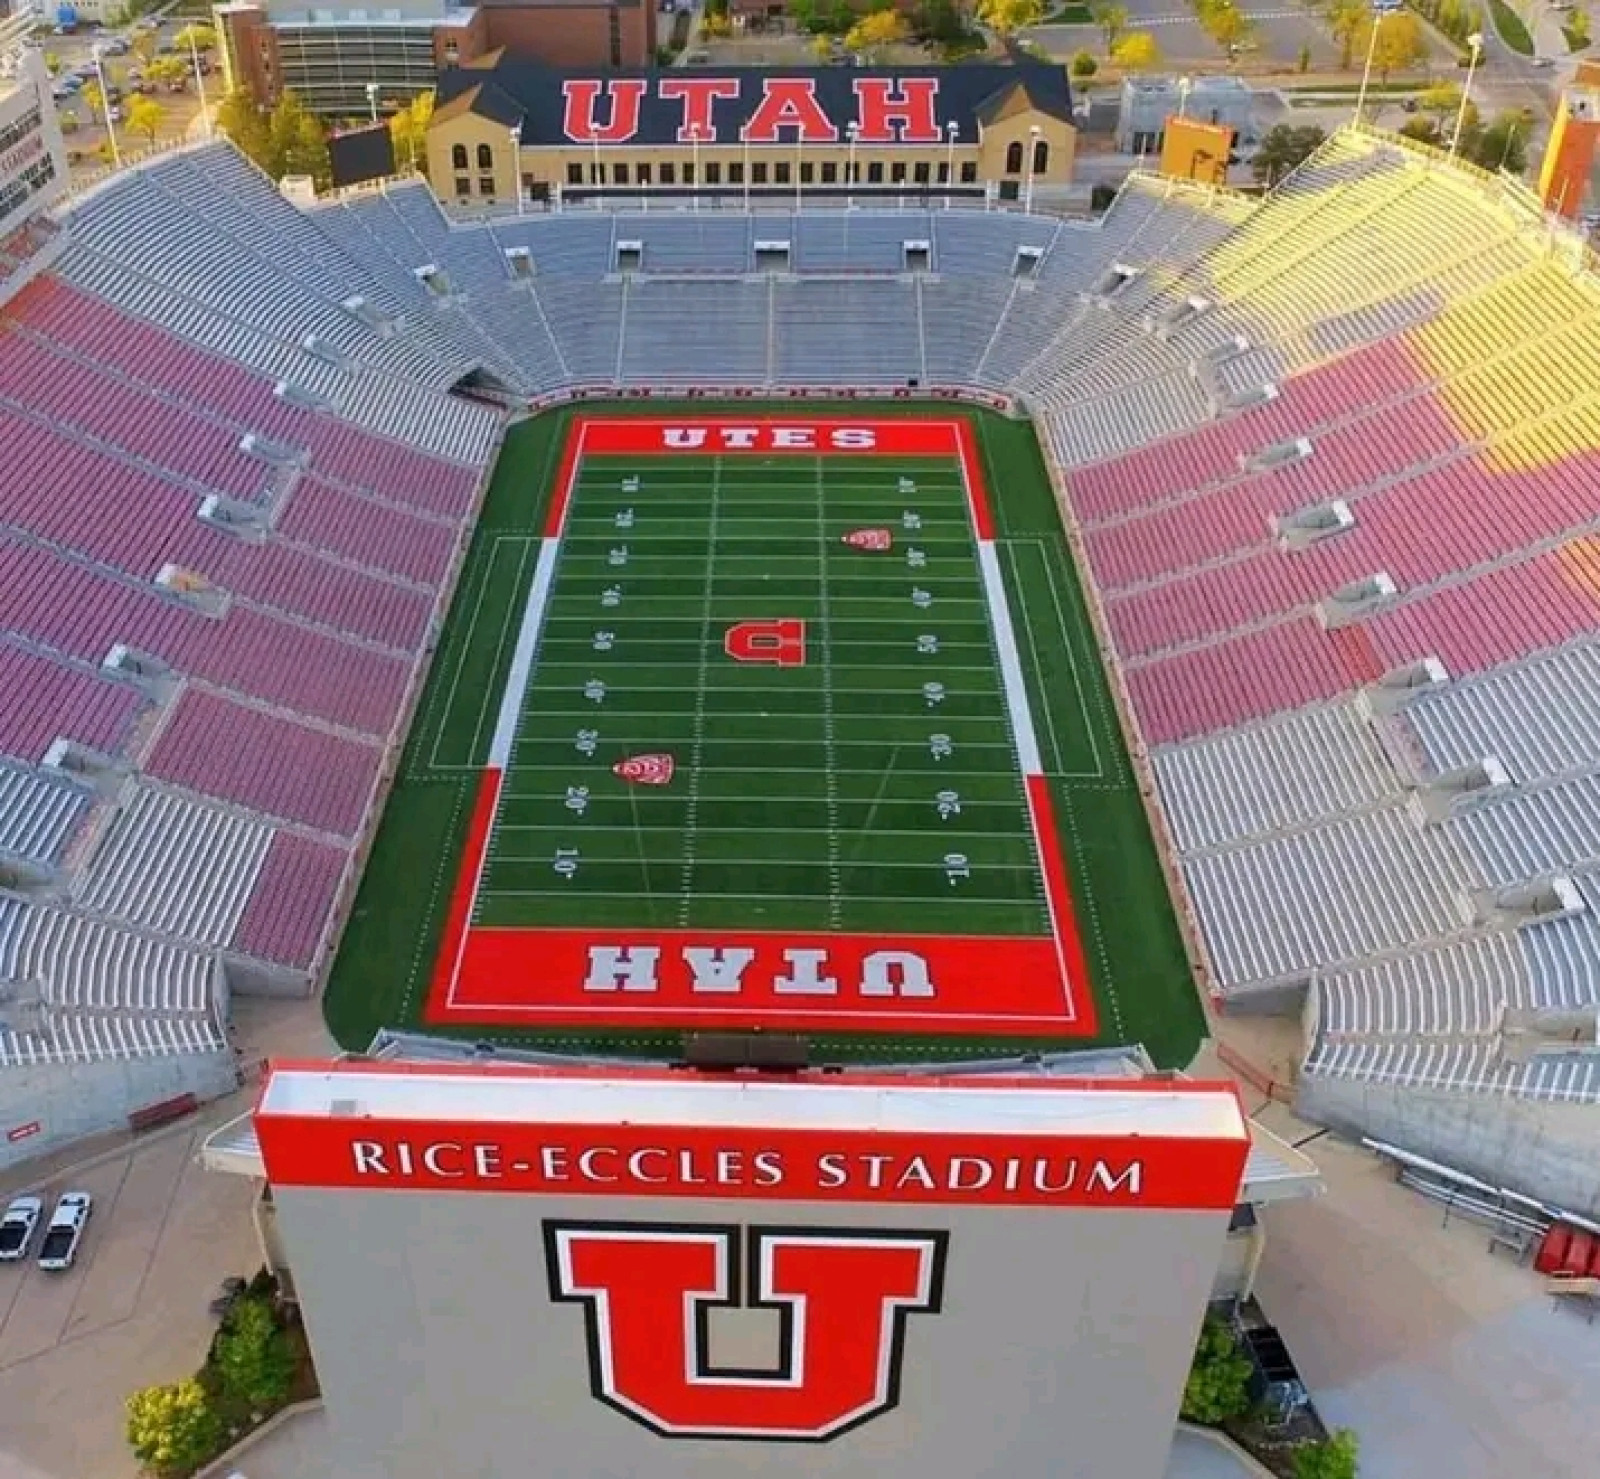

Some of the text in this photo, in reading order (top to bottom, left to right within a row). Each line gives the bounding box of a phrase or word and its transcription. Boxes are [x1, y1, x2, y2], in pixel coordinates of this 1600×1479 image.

[562, 78, 942, 142] UTAH
[661, 427, 878, 449] UTES
[592, 630, 615, 650] 50
[725, 619, 806, 667] U
[916, 634, 938, 654] 50
[583, 678, 606, 700] 40
[922, 681, 945, 702] 40
[575, 728, 599, 751] 30
[928, 733, 952, 756] 30
[565, 785, 590, 809] 20
[935, 790, 961, 814] 20
[552, 847, 580, 874] 10
[943, 852, 970, 878] 10
[583, 944, 935, 998] UTAH
[350, 1139, 1143, 1194] RICE-ECCLES STADIUM
[542, 1218, 950, 1444] U
